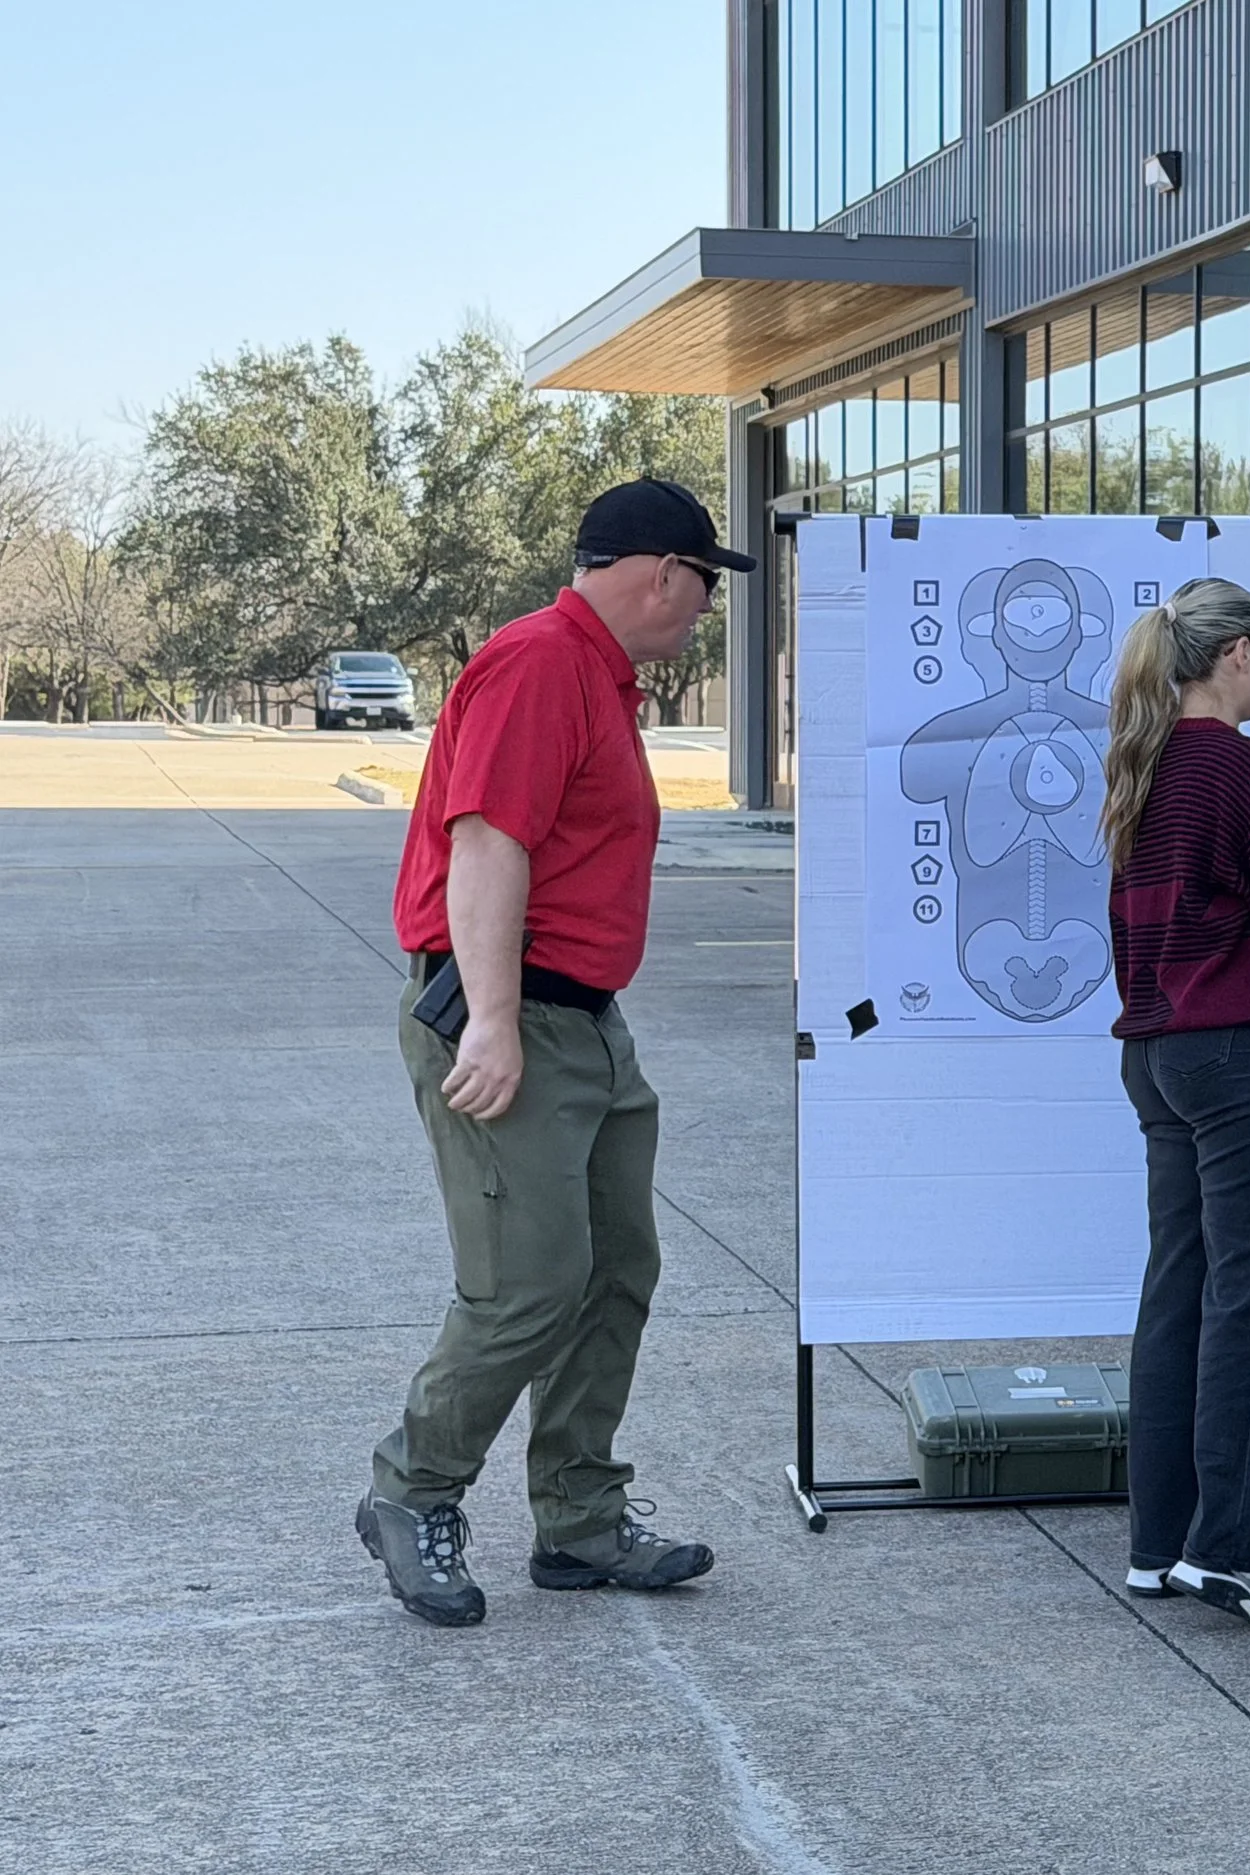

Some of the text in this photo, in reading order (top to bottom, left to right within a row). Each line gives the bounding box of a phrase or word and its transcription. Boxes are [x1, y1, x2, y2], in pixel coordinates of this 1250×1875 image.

[922, 587, 930, 599] 1
[1142, 588, 1152, 600] 2
[922, 625, 932, 637] 3
[923, 664, 933, 676] 5
[922, 828, 932, 840] 7
[922, 866, 932, 878] 9
[919, 903, 934, 915] 11
